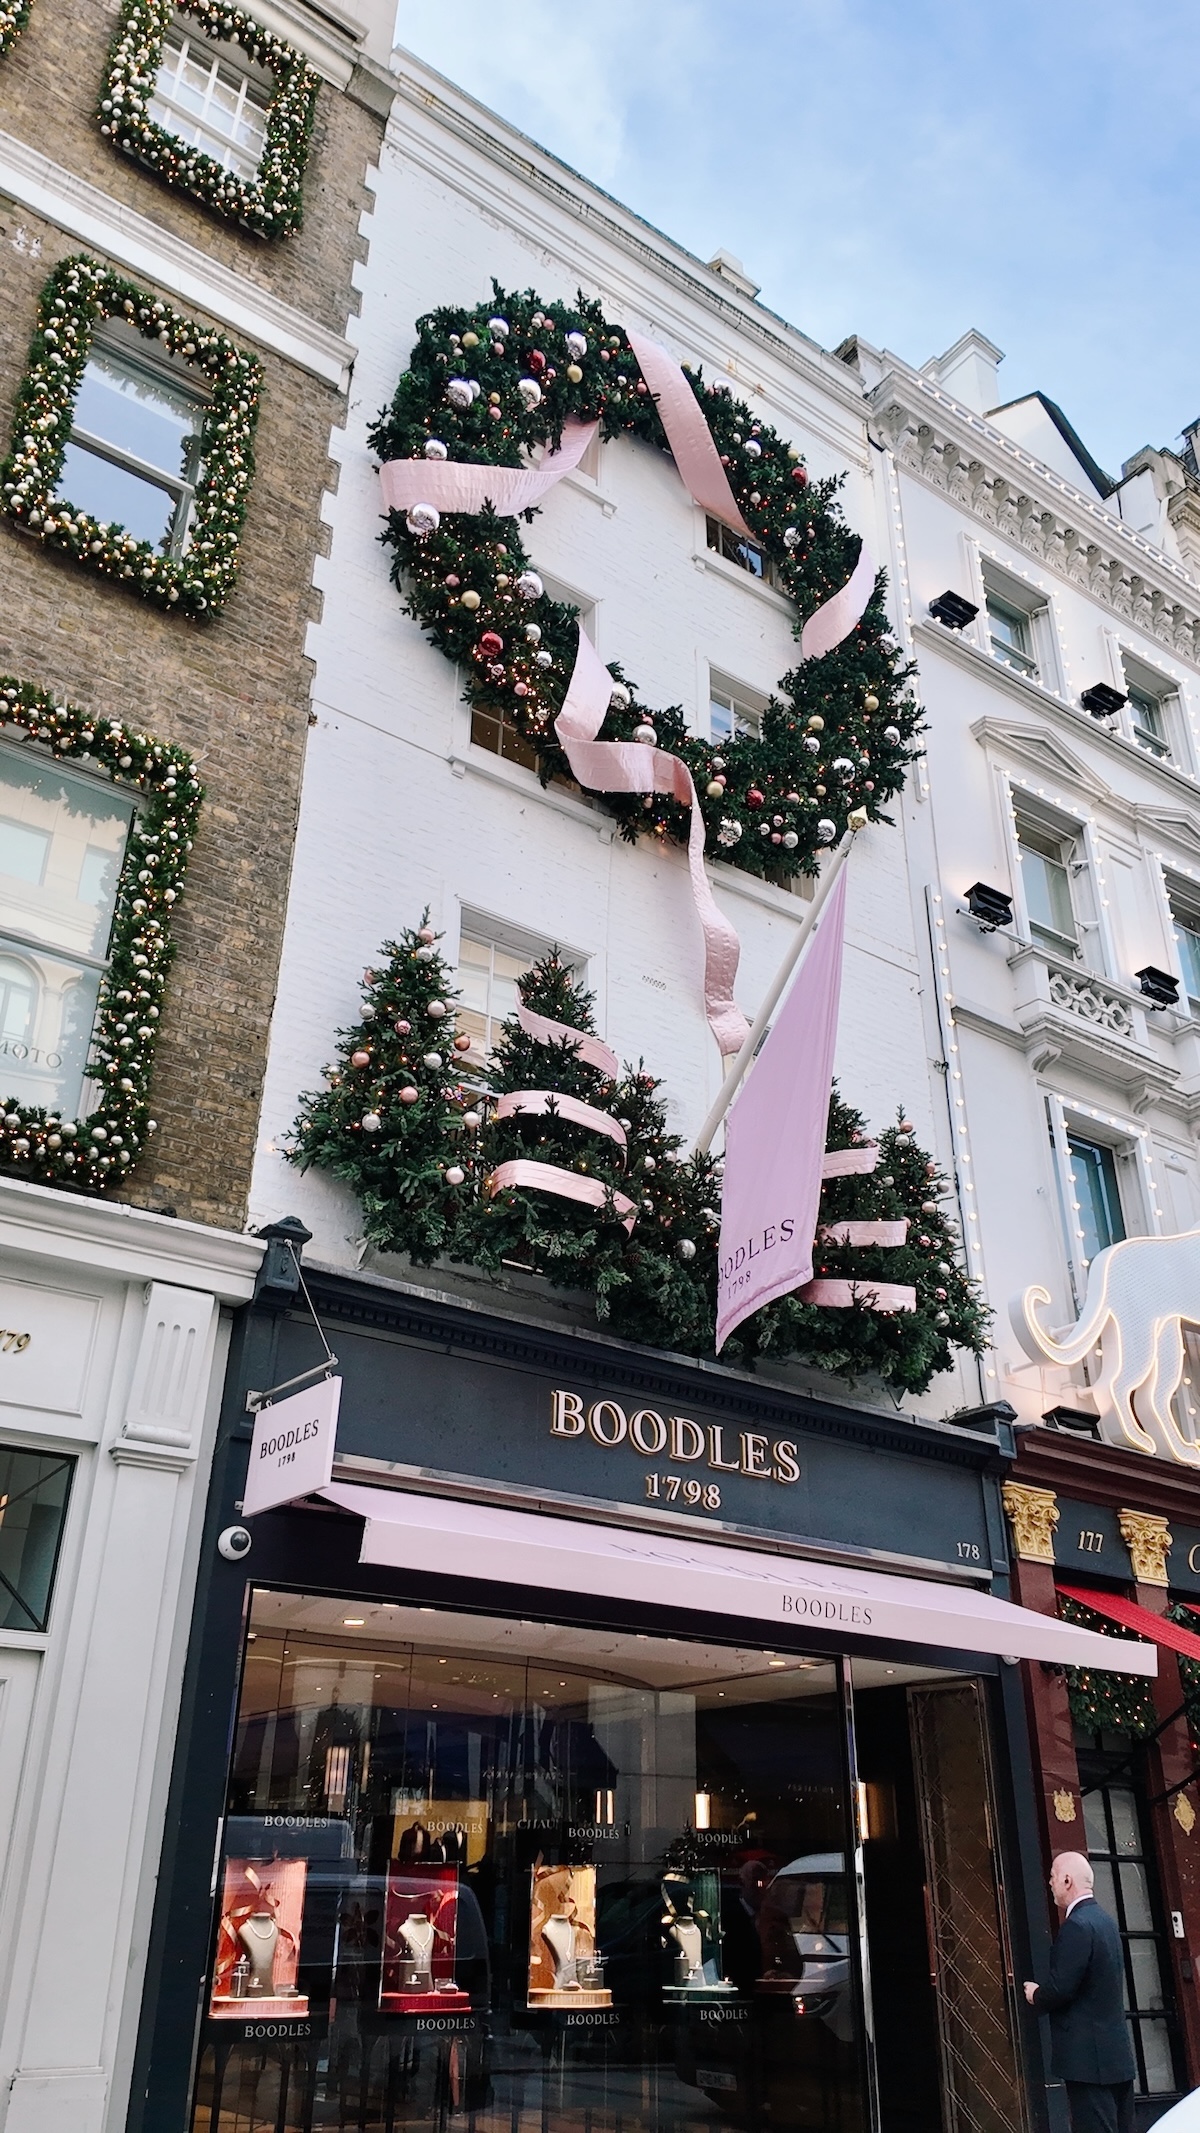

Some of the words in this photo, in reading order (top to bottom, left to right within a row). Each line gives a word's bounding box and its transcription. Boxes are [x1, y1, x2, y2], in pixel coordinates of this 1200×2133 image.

[728, 1270, 751, 1299] 1798
[259, 1419, 320, 1460] BOODLES
[550, 1389, 801, 1483] BOODLES
[277, 1451, 296, 1468] 1798
[646, 1472, 722, 1511] 1798
[1078, 1530, 1104, 1553] 177
[956, 1541, 981, 1560] 178
[781, 1594, 874, 1626] BOODLES
[263, 1815, 328, 1829] BOODLES
[426, 1821, 484, 1834] BOODLES
[568, 1827, 620, 1840] BOODLES
[697, 1832, 743, 1845] BOODLES
[567, 2013, 620, 2026] BOODLES
[700, 2009, 748, 2021] BOODLES
[244, 2023, 312, 2039] BOODLES
[416, 2017, 476, 2031] BOODLES
